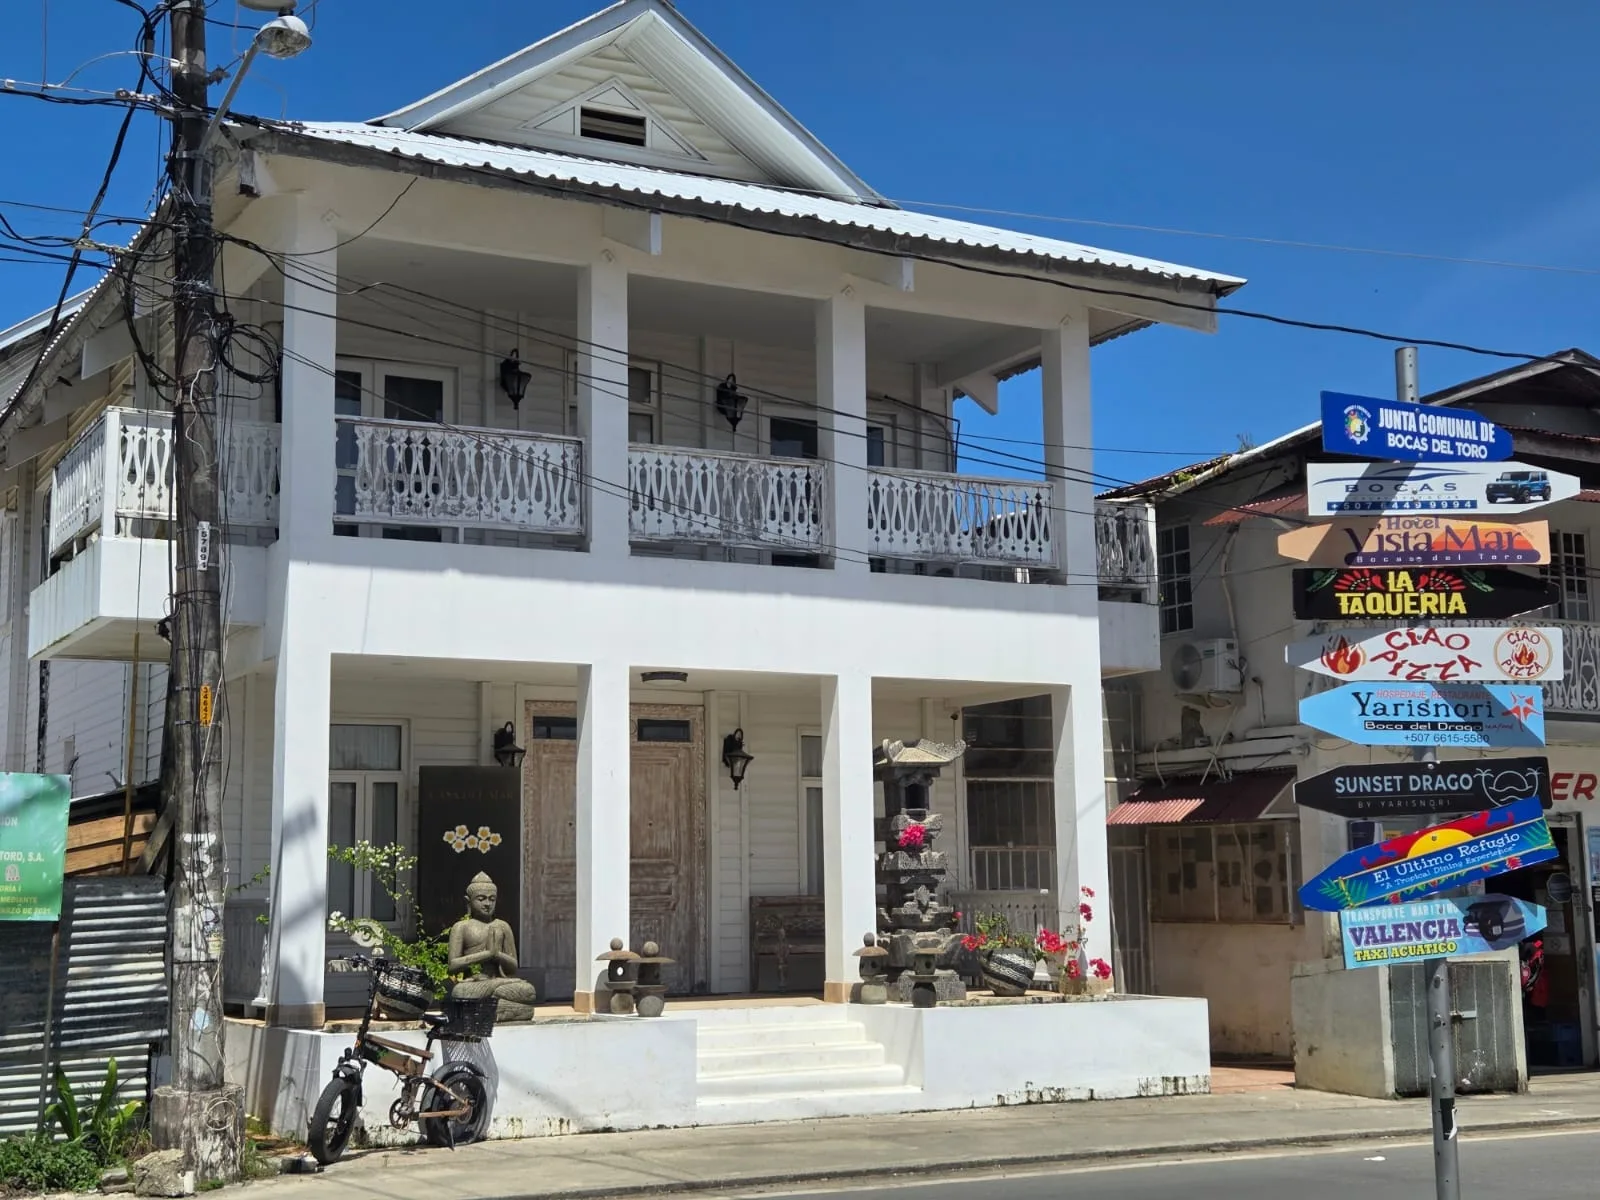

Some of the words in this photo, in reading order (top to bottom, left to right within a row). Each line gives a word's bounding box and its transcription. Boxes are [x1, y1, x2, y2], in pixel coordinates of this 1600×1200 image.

[1379, 408, 1417, 432] JUNTA
[1419, 413, 1478, 440] COMUNAL
[1480, 421, 1496, 443] DE
[1388, 433, 1428, 451] BOCAS
[1432, 438, 1454, 455] DEL
[1456, 442, 1488, 459] TORO
[1345, 482, 1457, 492] BOCAS
[1386, 515, 1440, 530] Hotel
[1343, 524, 1433, 553] Vista
[1445, 525, 1524, 552] Mar
[1356, 555, 1415, 563] Bocas
[1387, 571, 1414, 592] LA
[1335, 592, 1468, 615] TAQUERIA
[1351, 691, 1495, 718] Yarisnori
[1365, 721, 1404, 730] Boca
[1410, 722, 1431, 730] del
[1438, 722, 1482, 732] Drago
[1404, 733, 1430, 742] +507
[1433, 733, 1490, 743] 6615-5580
[1335, 775, 1403, 793] SUNSET
[1409, 773, 1474, 791] DRAGO
[1358, 801, 1372, 809] BY
[1380, 799, 1451, 808] YARISNORI
[1373, 870, 1391, 884] El
[1394, 853, 1453, 876] Ultimo
[1457, 833, 1520, 858] Refugio
[1394, 868, 1431, 886] Tropical
[1433, 860, 1463, 875] Dining
[1345, 906, 1406, 923] TRANSPORTE
[1348, 918, 1462, 947] VALENCIA
[1355, 948, 1389, 962] TAXI
[1391, 941, 1457, 958] ACUATICO
